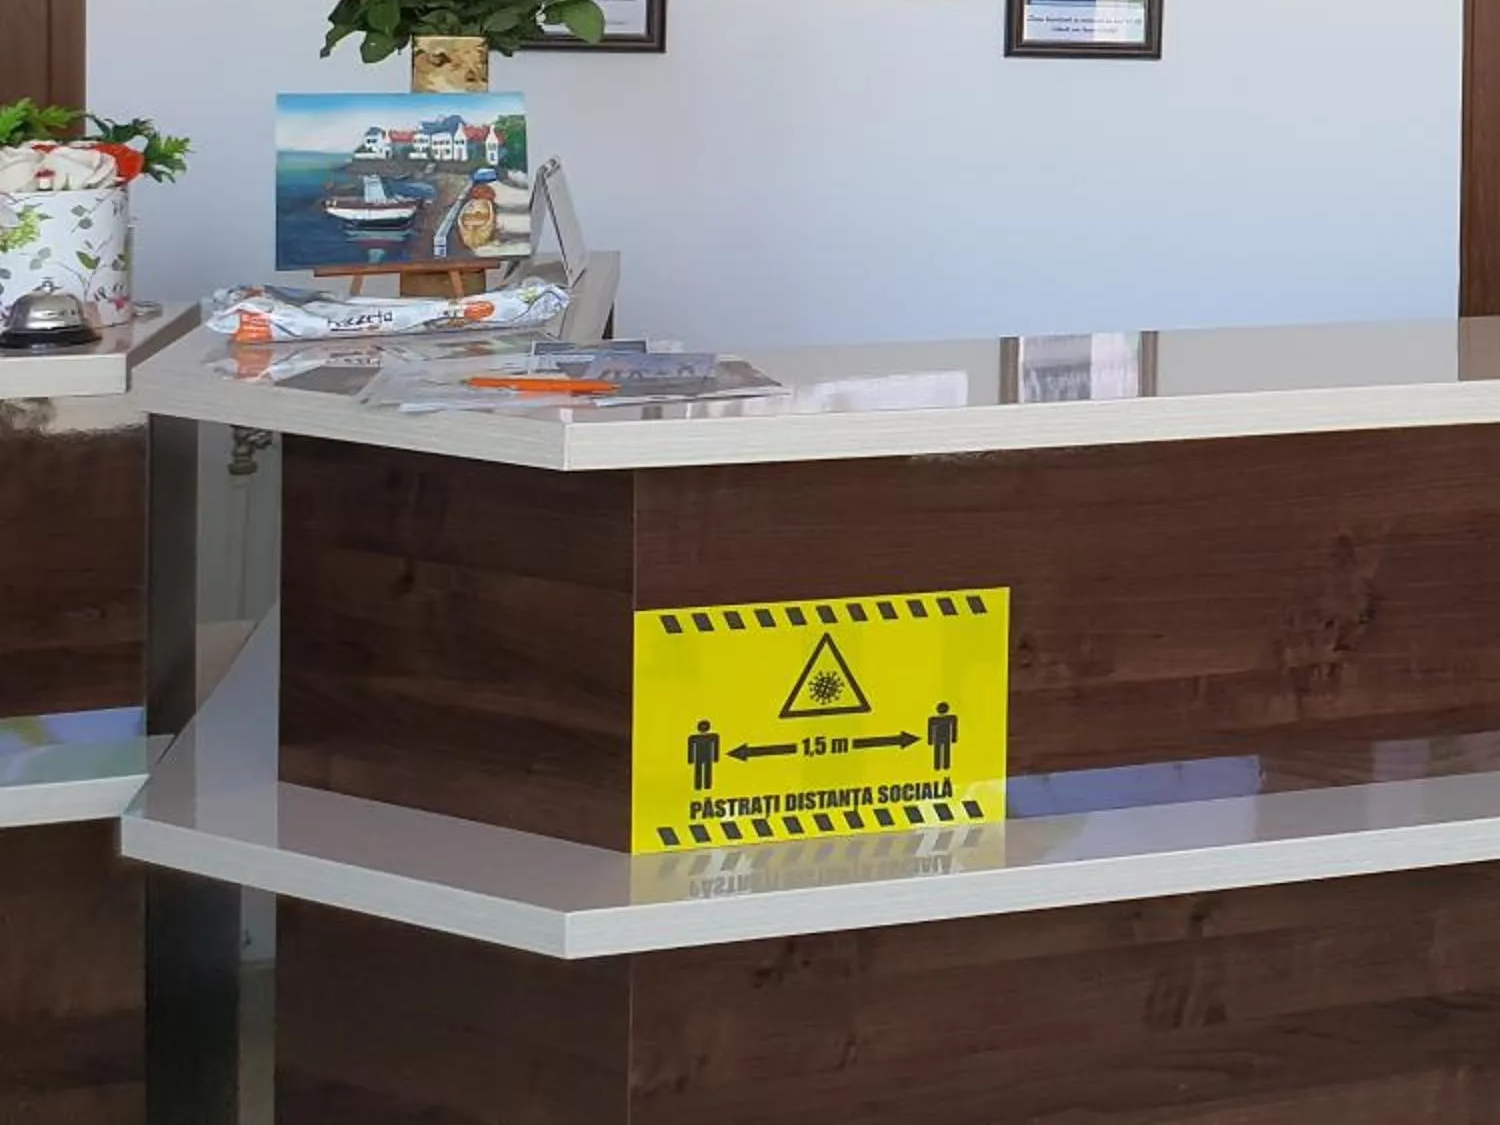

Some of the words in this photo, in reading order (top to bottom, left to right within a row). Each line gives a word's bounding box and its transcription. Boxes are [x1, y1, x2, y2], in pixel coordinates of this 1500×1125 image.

[802, 737, 827, 758] 1,5
[831, 737, 849, 753] m
[878, 776, 953, 804] SOCIALĂ
